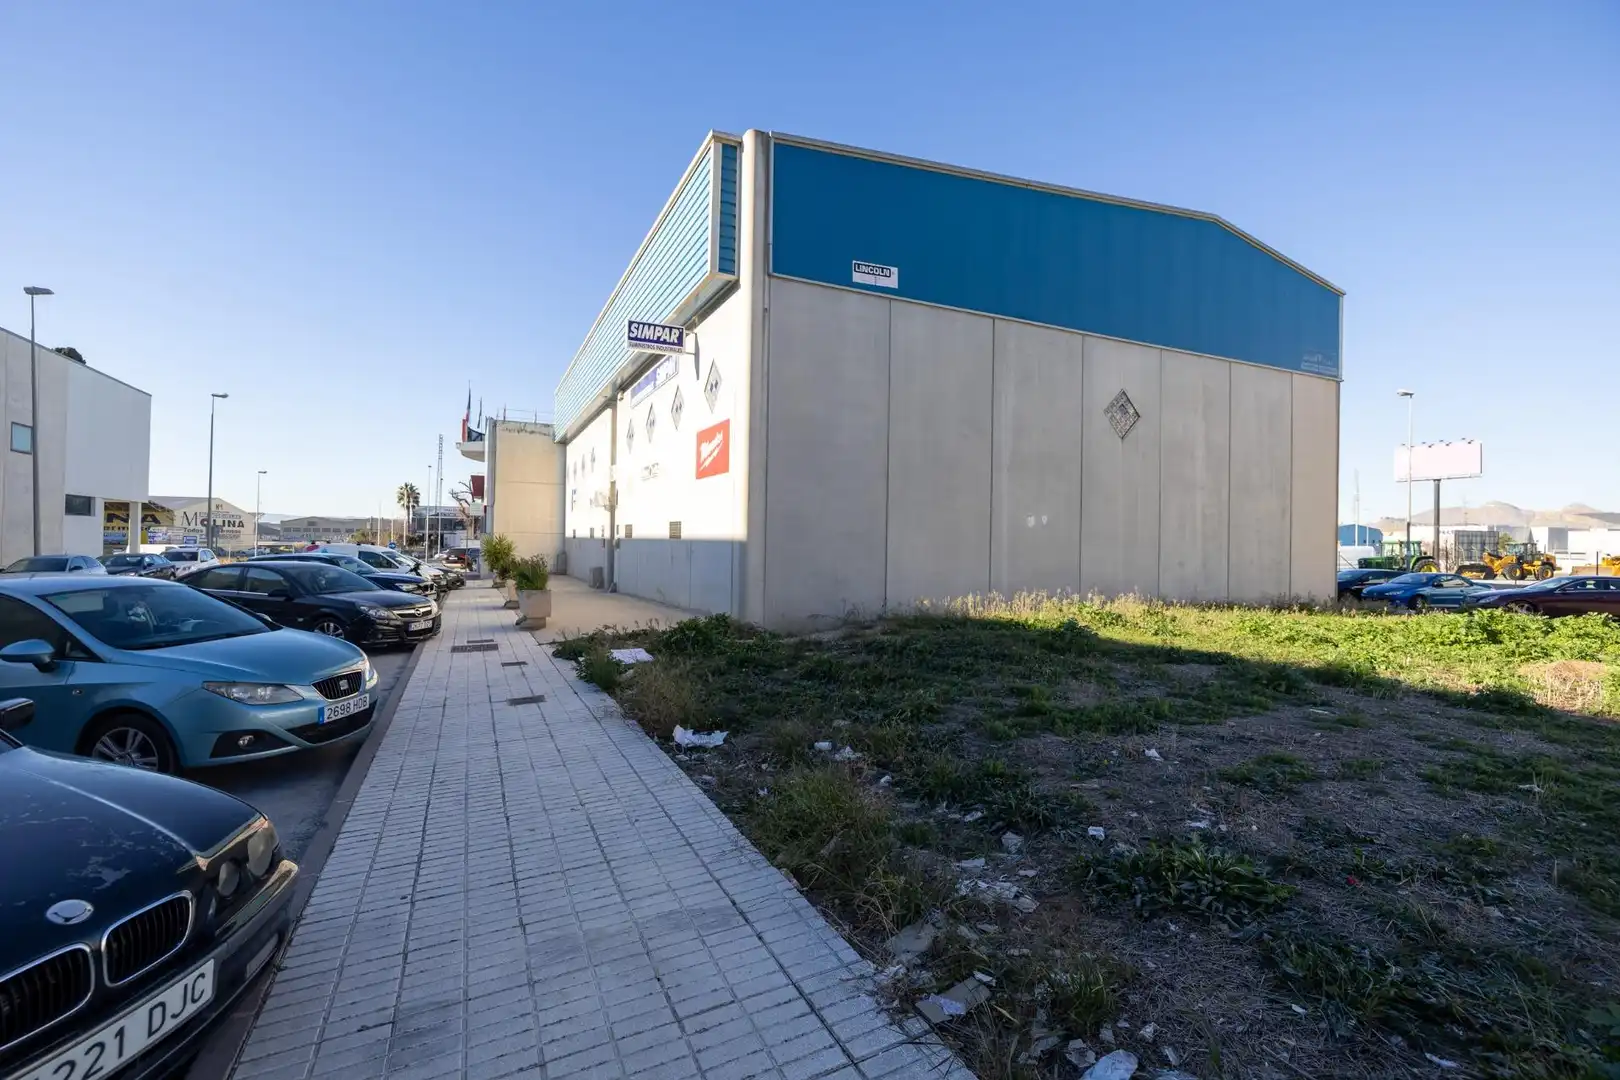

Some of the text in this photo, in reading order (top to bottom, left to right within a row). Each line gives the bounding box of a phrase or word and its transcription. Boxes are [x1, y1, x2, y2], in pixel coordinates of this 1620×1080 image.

[855, 263, 890, 277] LINCOLN
[630, 322, 680, 343] SIMPAR
[181, 511, 245, 528] MOLINA
[327, 702, 351, 720] 2698
[34, 972, 206, 1080] 221 DJC
